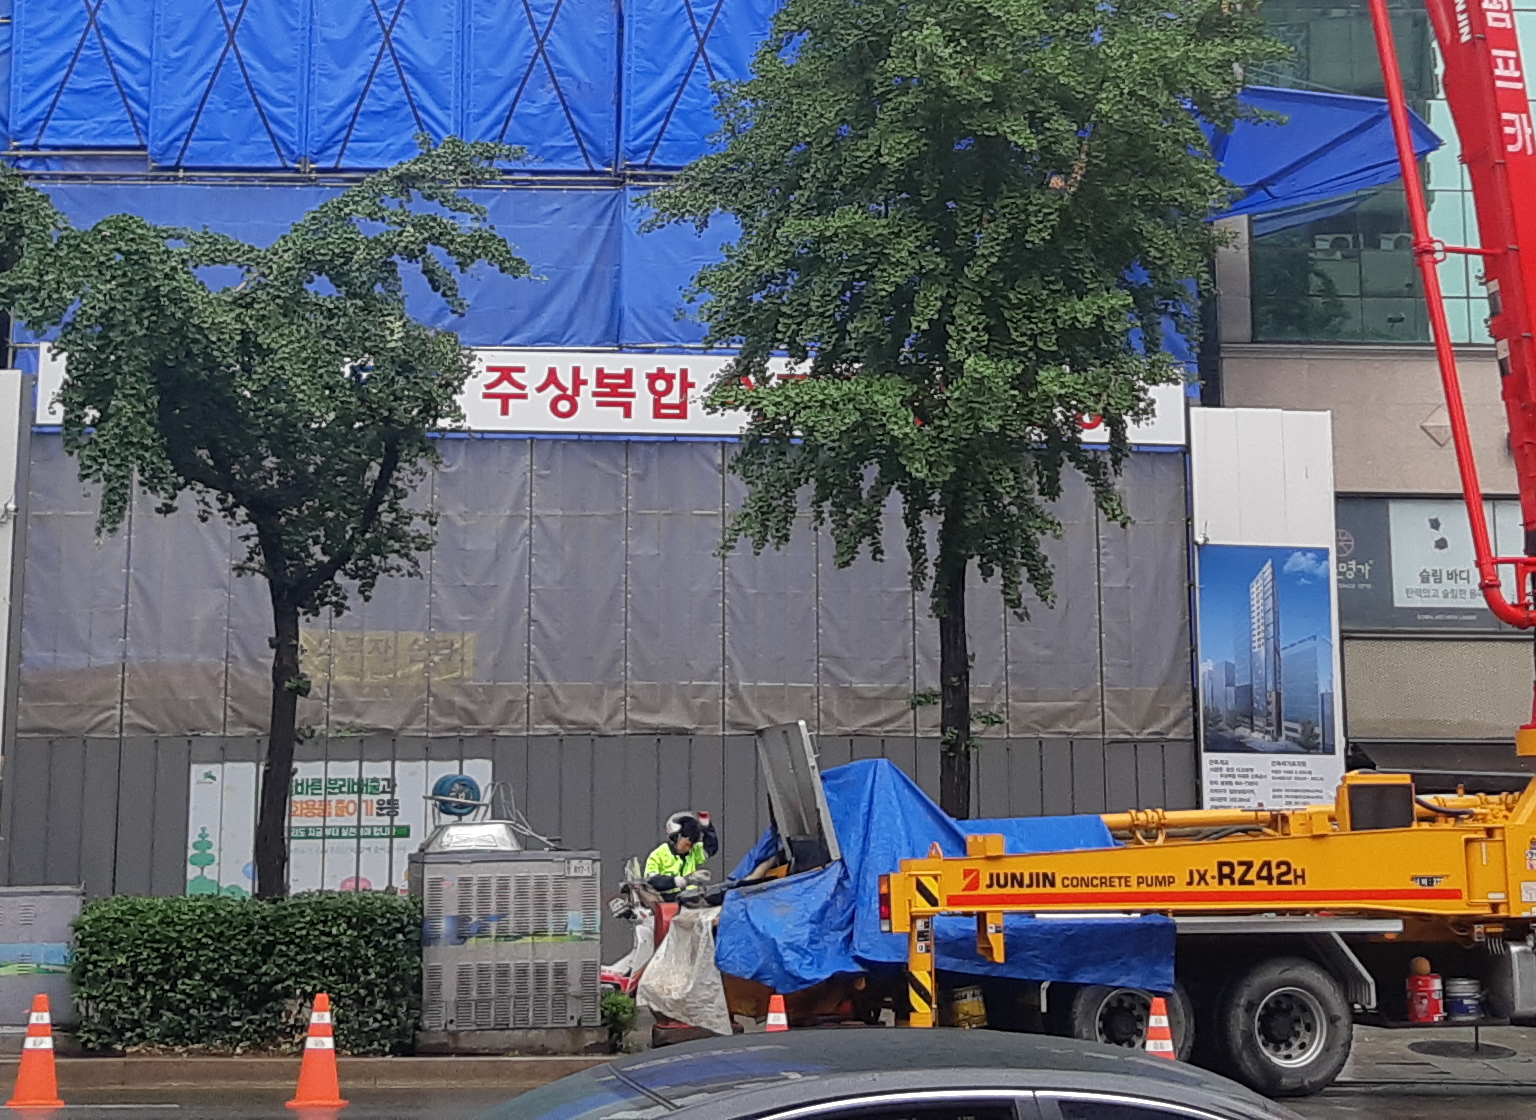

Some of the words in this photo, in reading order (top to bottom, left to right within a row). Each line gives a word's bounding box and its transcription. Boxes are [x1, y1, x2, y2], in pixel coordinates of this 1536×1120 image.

[482, 365, 695, 420] 주상복합
[1446, 568, 1470, 584] 바디
[985, 871, 1056, 888] JUNJIN
[1060, 875, 1132, 888] CONCRETE
[1136, 875, 1176, 888] PUMP
[1184, 860, 1307, 888] JX-RZ42H
